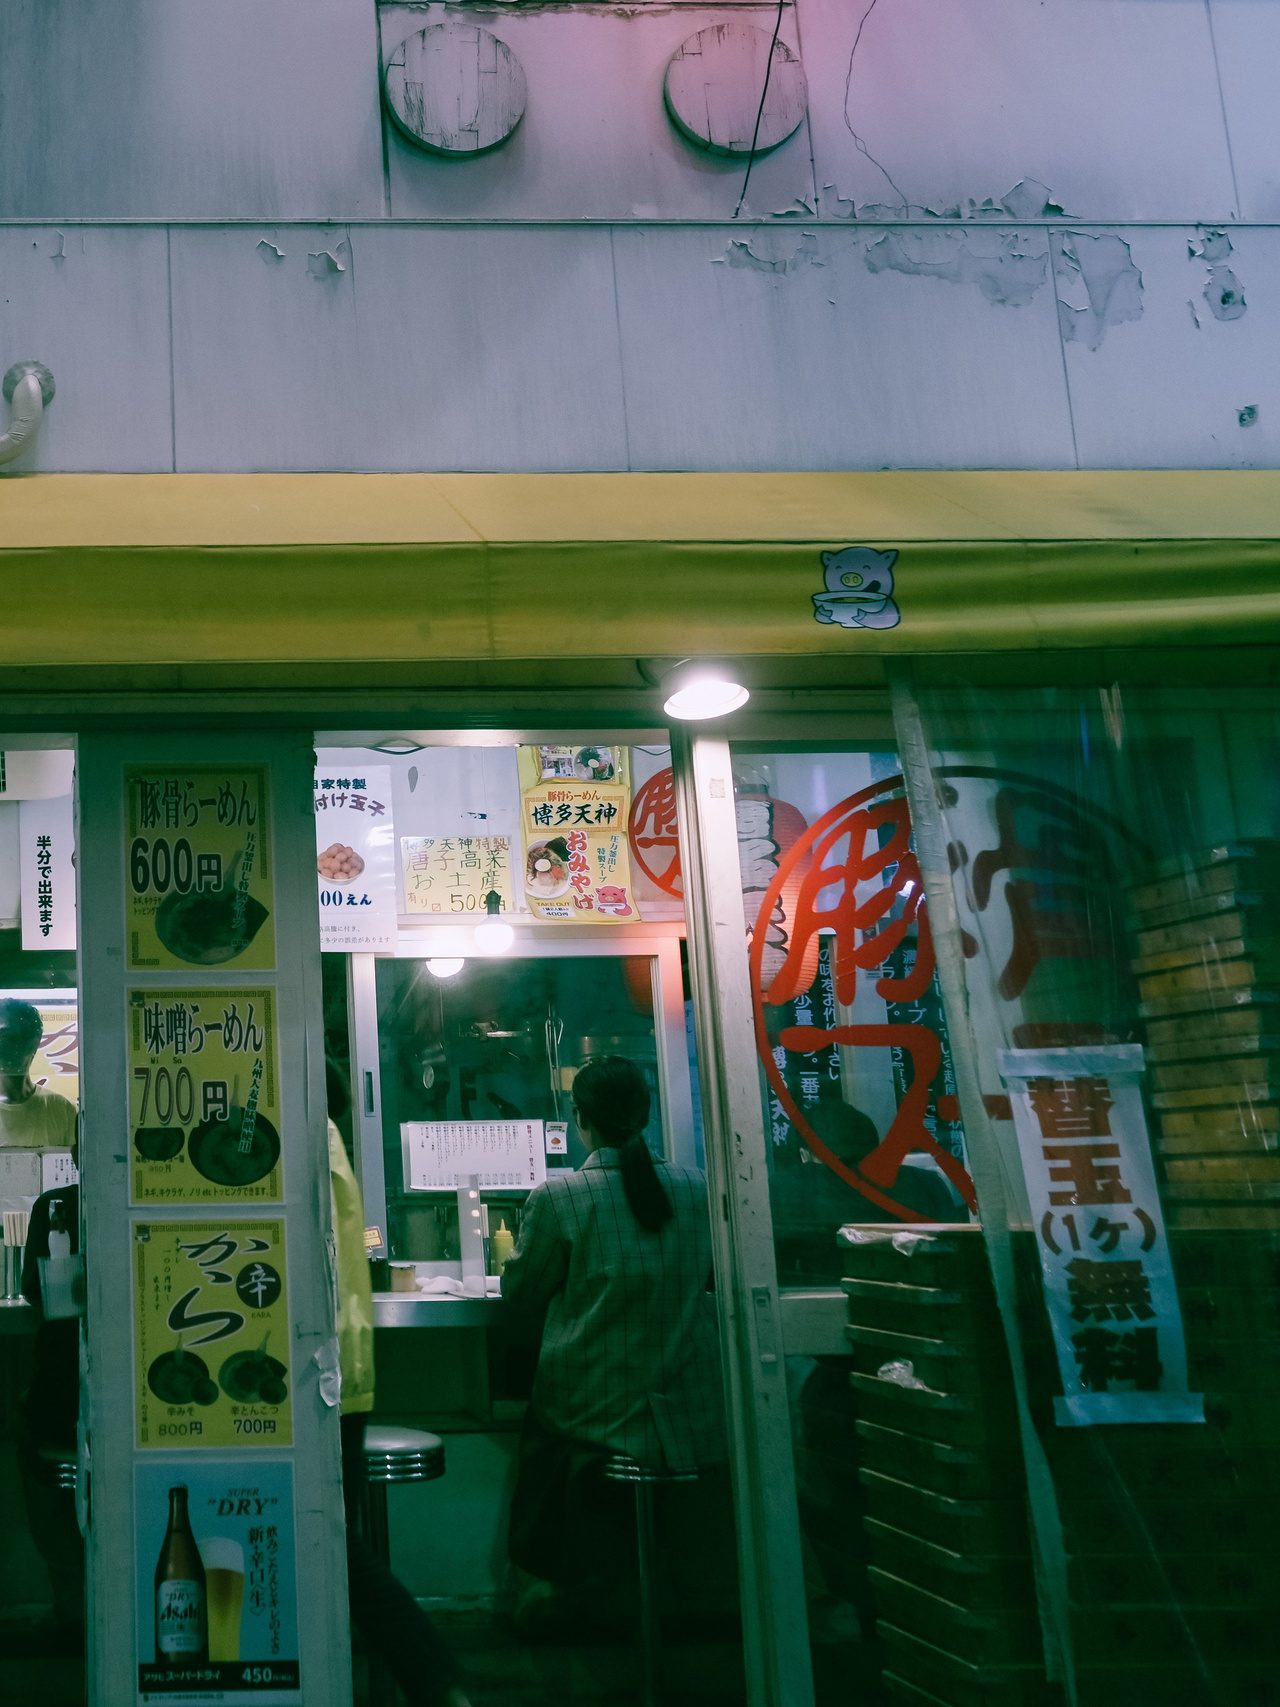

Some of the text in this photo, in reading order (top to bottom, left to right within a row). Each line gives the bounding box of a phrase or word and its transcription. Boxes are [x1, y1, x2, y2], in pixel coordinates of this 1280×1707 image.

[140, 779, 257, 829] 豚骨らーめん
[531, 802, 618, 826] 博多天神
[547, 790, 602, 802] 豚骨らーめん
[36, 835, 54, 938] 半分で出来ます
[131, 838, 224, 893] 600円
[412, 868, 503, 891] お土産
[567, 832, 596, 911] おみやげ
[144, 1002, 264, 1055] 味噌らーめん
[134, 1066, 229, 1124] 700円
[239, 1264, 277, 1308] 辛
[158, 1418, 277, 1436] 800円 700円
[166, 1404, 279, 1416] 辛みそ 辛とんこつ
[227, 1488, 260, 1497] SUPER
